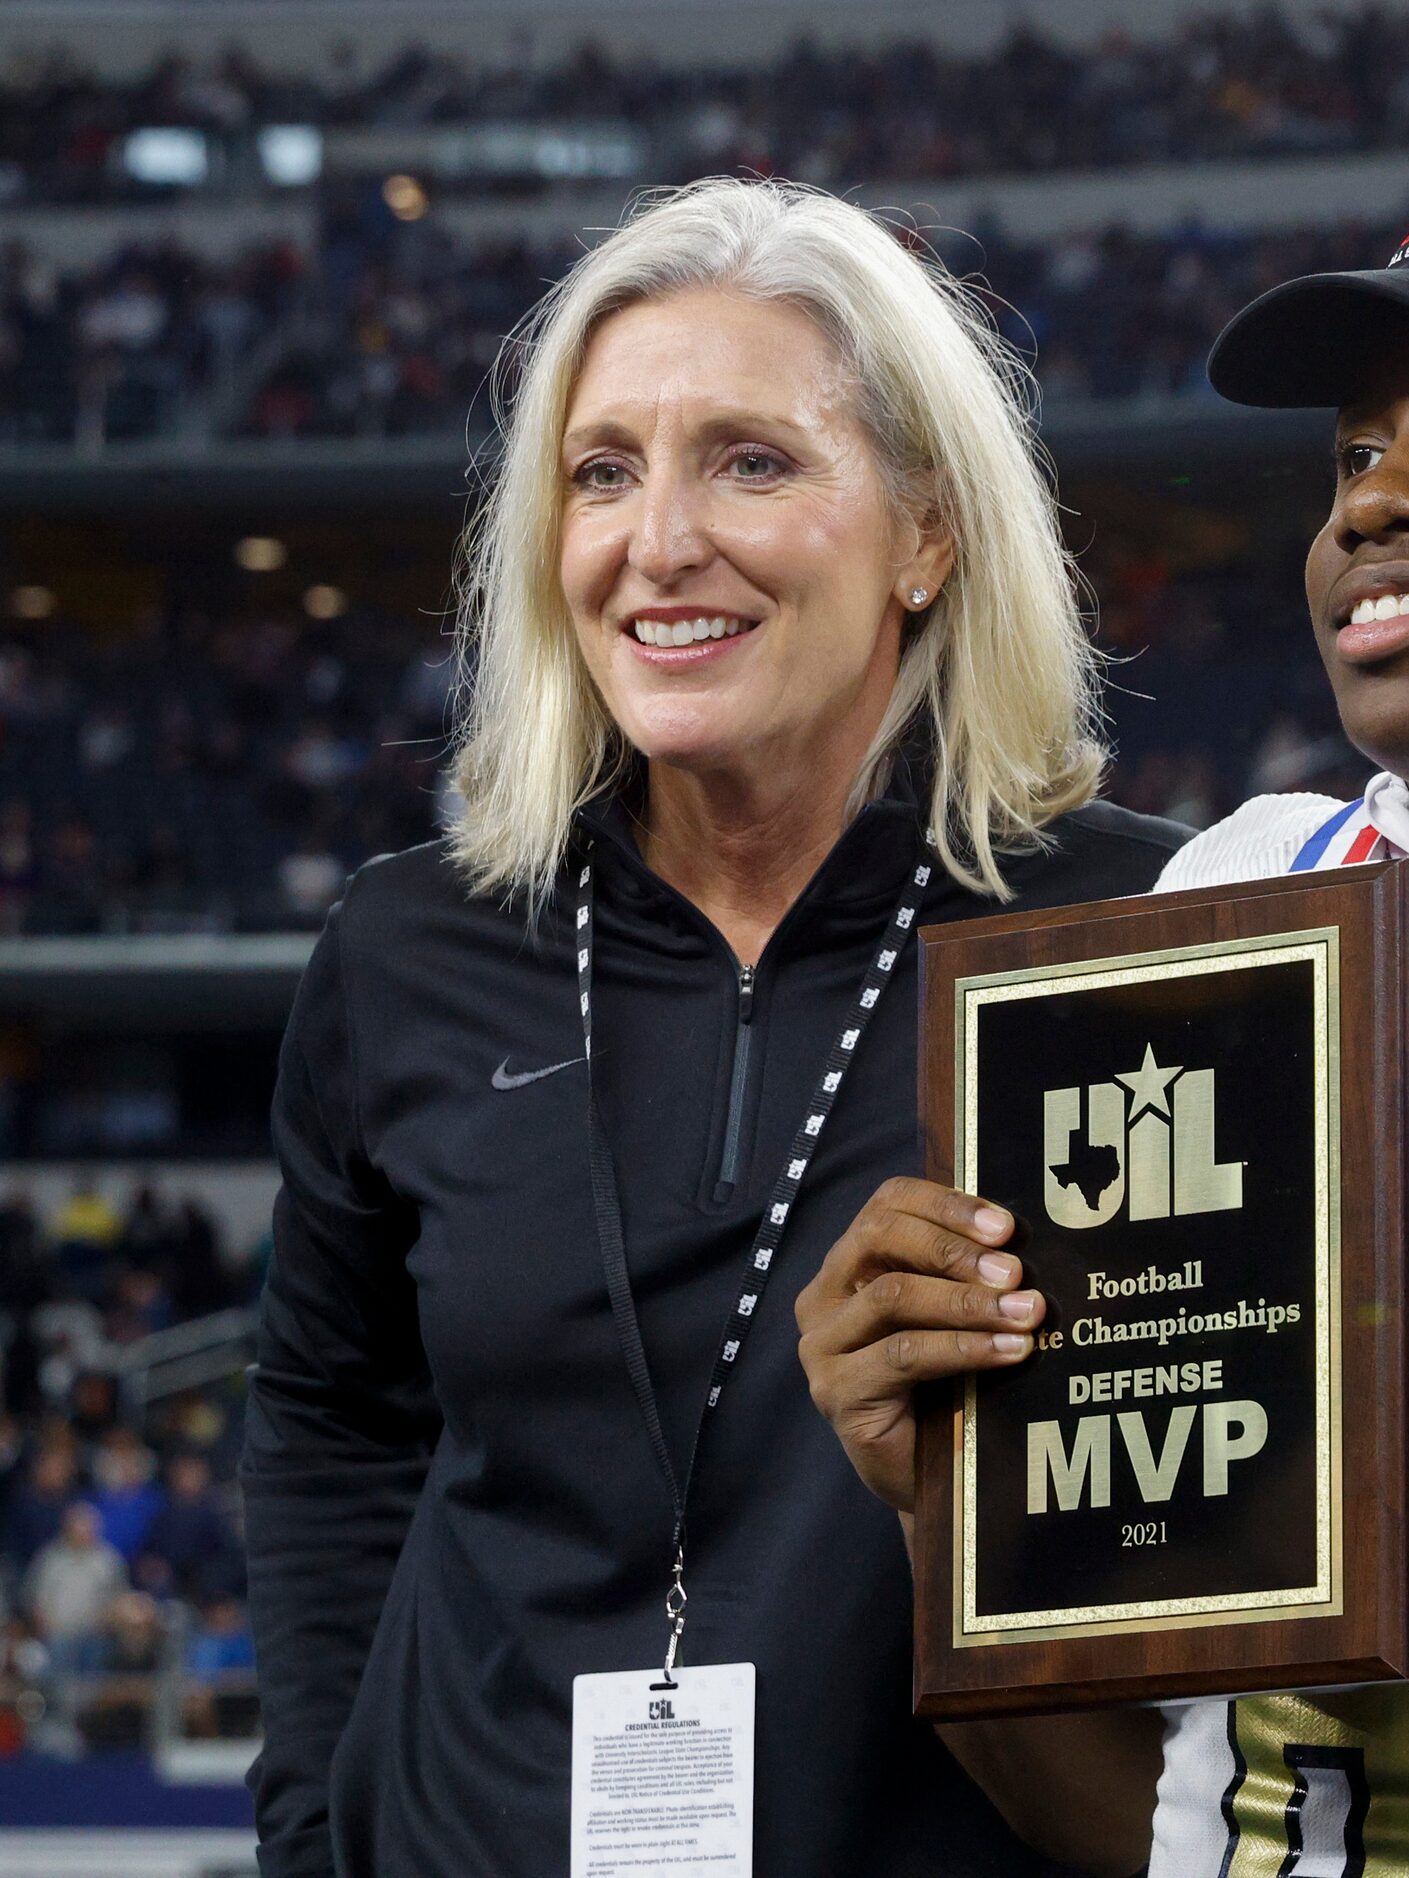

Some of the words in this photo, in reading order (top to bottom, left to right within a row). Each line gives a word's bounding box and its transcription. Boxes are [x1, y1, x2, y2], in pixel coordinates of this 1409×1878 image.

[1087, 1260, 1204, 1300] Football
[1071, 1298, 1301, 1346] Championships
[1069, 1359, 1223, 1405] DEFENSE
[1027, 1399, 1268, 1515] MVP
[1121, 1521, 1168, 1547] 2021
[625, 1723, 660, 1731] CREDENTIAL
[661, 1720, 700, 1729] REGULATIONS
